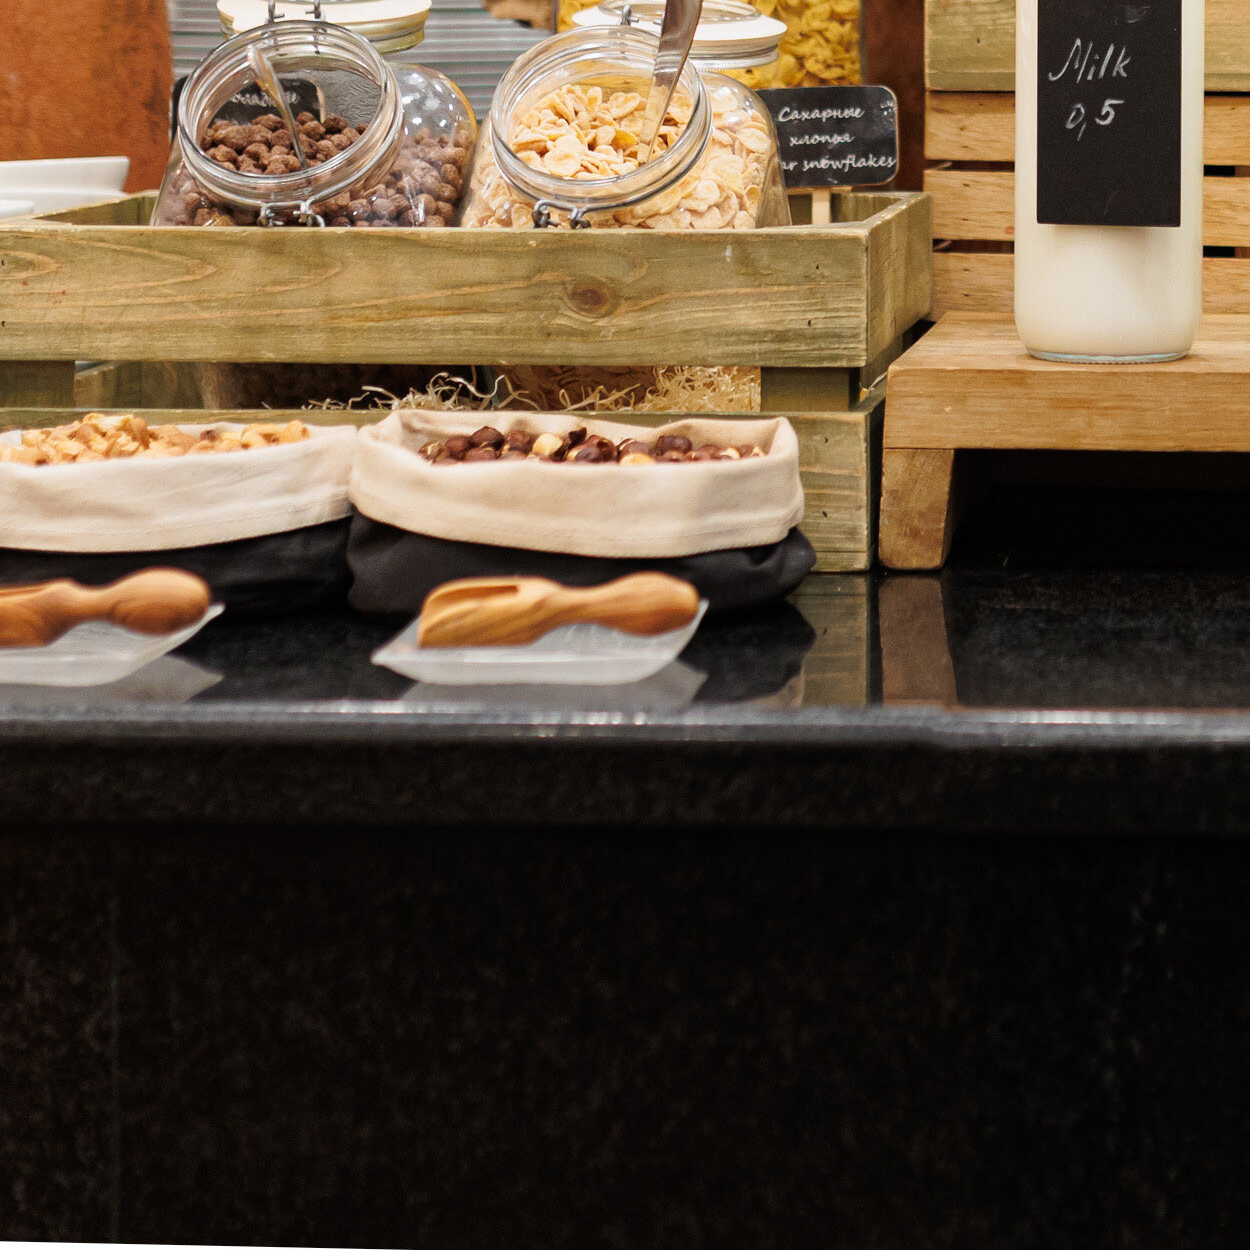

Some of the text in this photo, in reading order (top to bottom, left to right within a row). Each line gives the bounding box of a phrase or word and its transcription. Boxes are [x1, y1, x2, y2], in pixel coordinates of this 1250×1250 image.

[1049, 38, 1131, 83] Milk
[778, 107, 865, 122] Сахарные
[789, 133, 855, 147] хлопья
[803, 153, 898, 172] snowflakes
